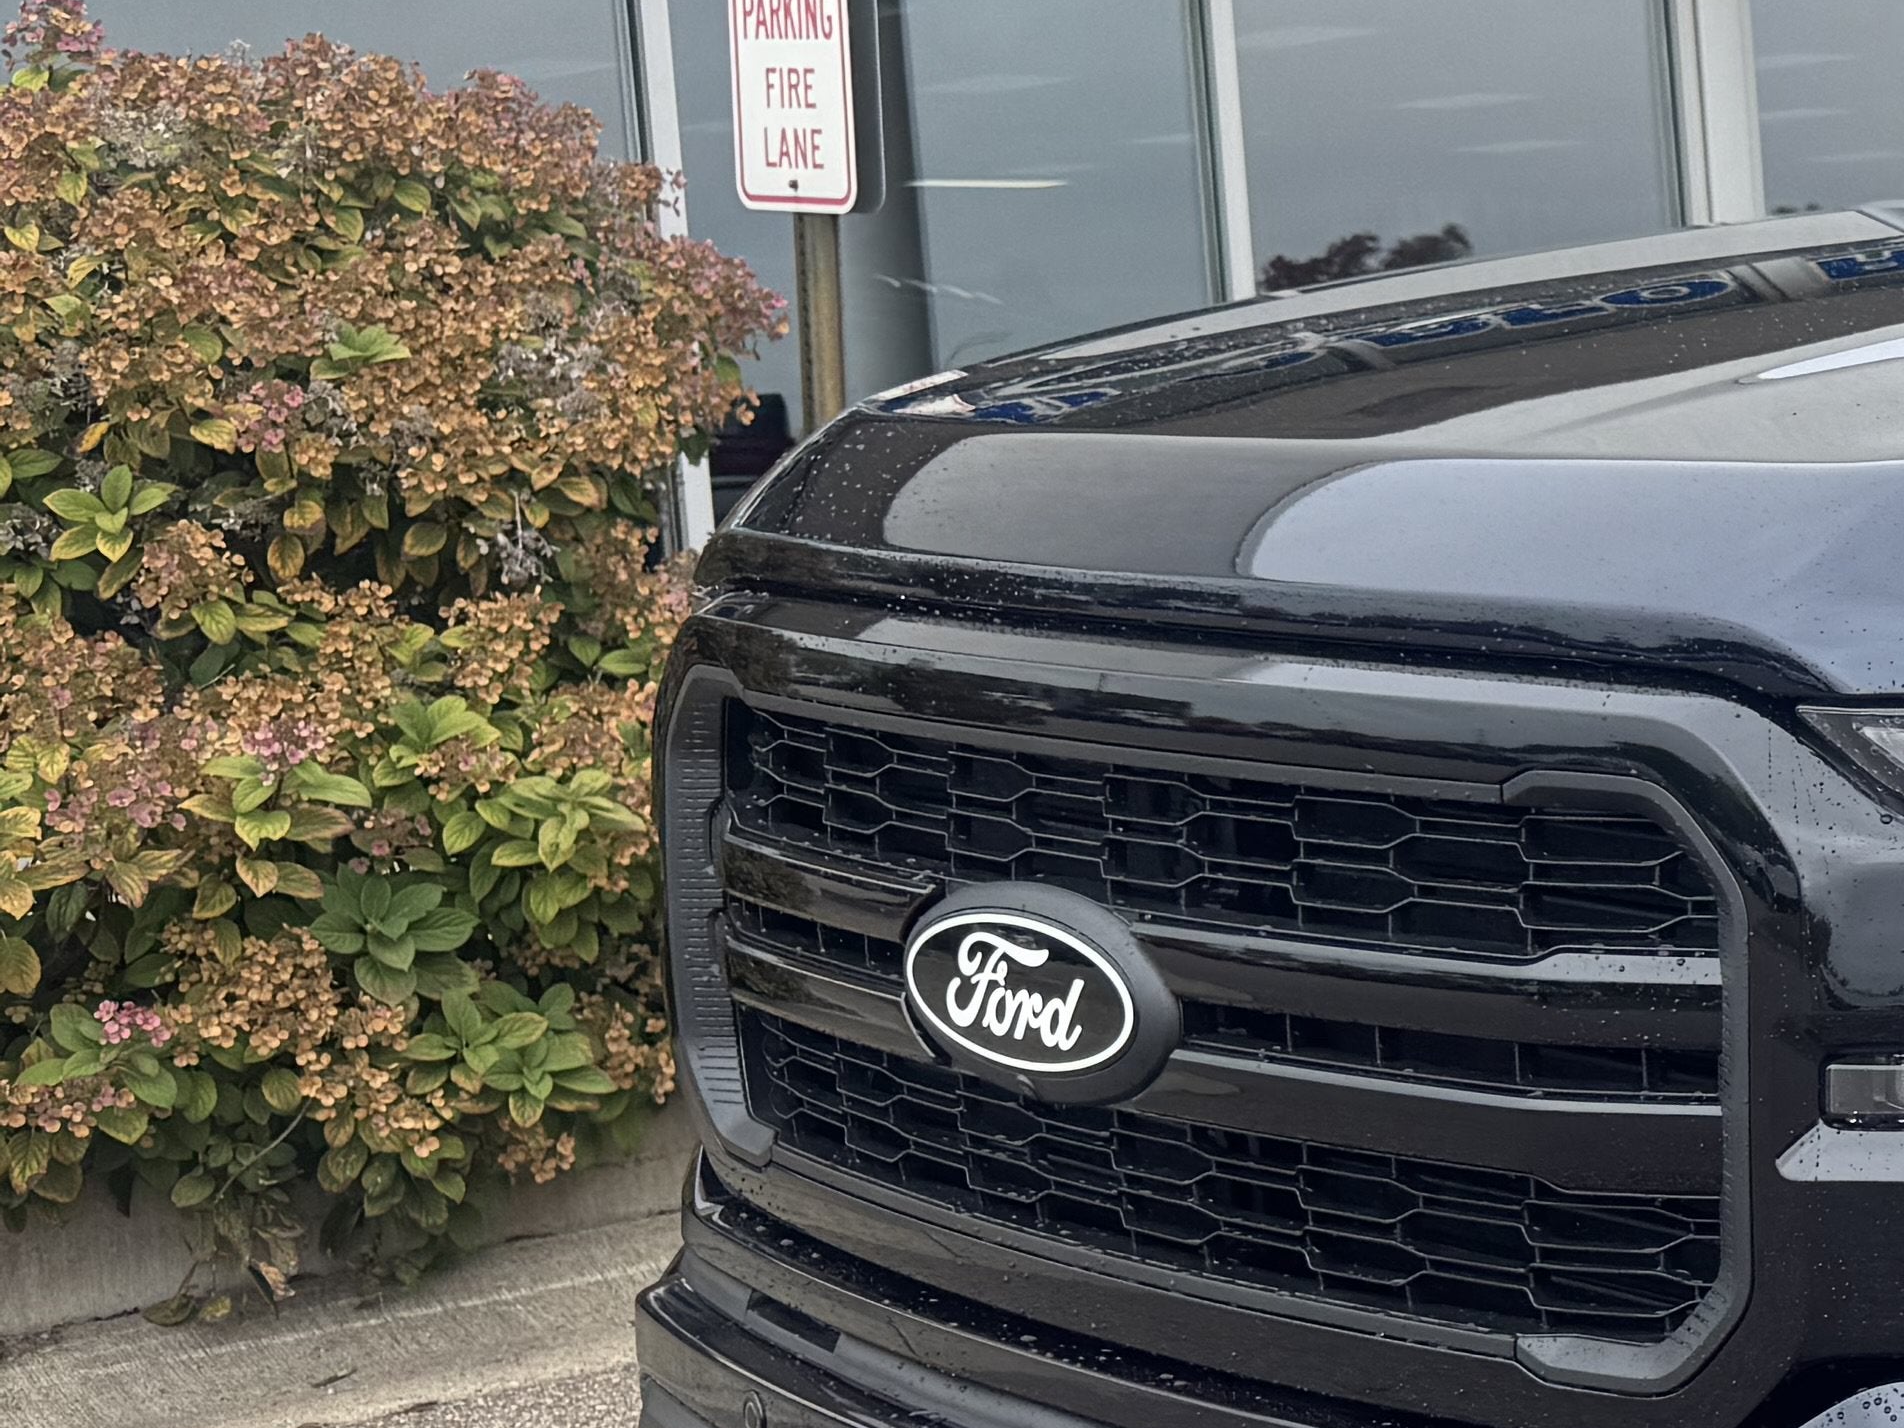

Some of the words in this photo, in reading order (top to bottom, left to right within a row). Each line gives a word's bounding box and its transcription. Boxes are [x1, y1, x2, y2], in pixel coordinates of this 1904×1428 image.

[765, 67, 817, 110] FIRE
[763, 127, 825, 170] LANE
[945, 931, 1085, 1051] Ford
